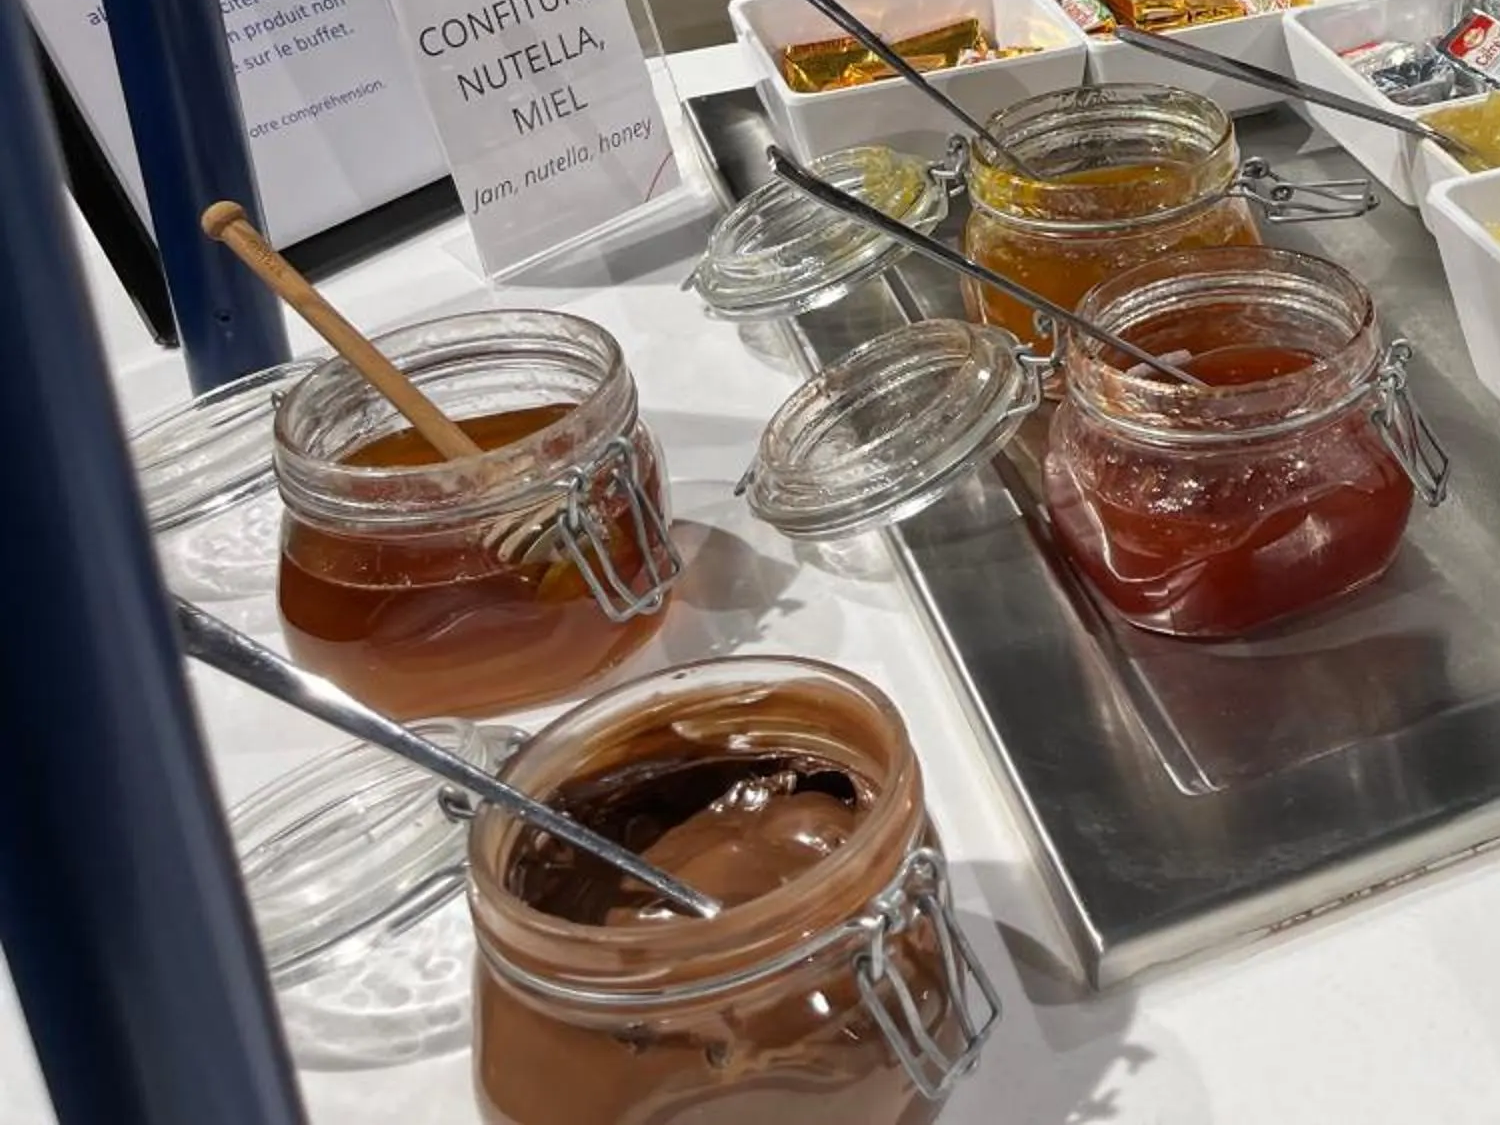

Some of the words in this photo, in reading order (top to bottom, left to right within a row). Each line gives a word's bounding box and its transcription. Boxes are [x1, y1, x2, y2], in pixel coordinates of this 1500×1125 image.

[244, 3, 310, 41] produit
[244, 51, 275, 70] sur
[274, 44, 293, 58] le
[458, 26, 605, 102] NUTELLA,
[250, 119, 279, 138] otre
[512, 85, 588, 135] MIEL
[473, 179, 518, 214] Jam,
[525, 142, 593, 188] nutella,
[599, 119, 652, 154] honey
